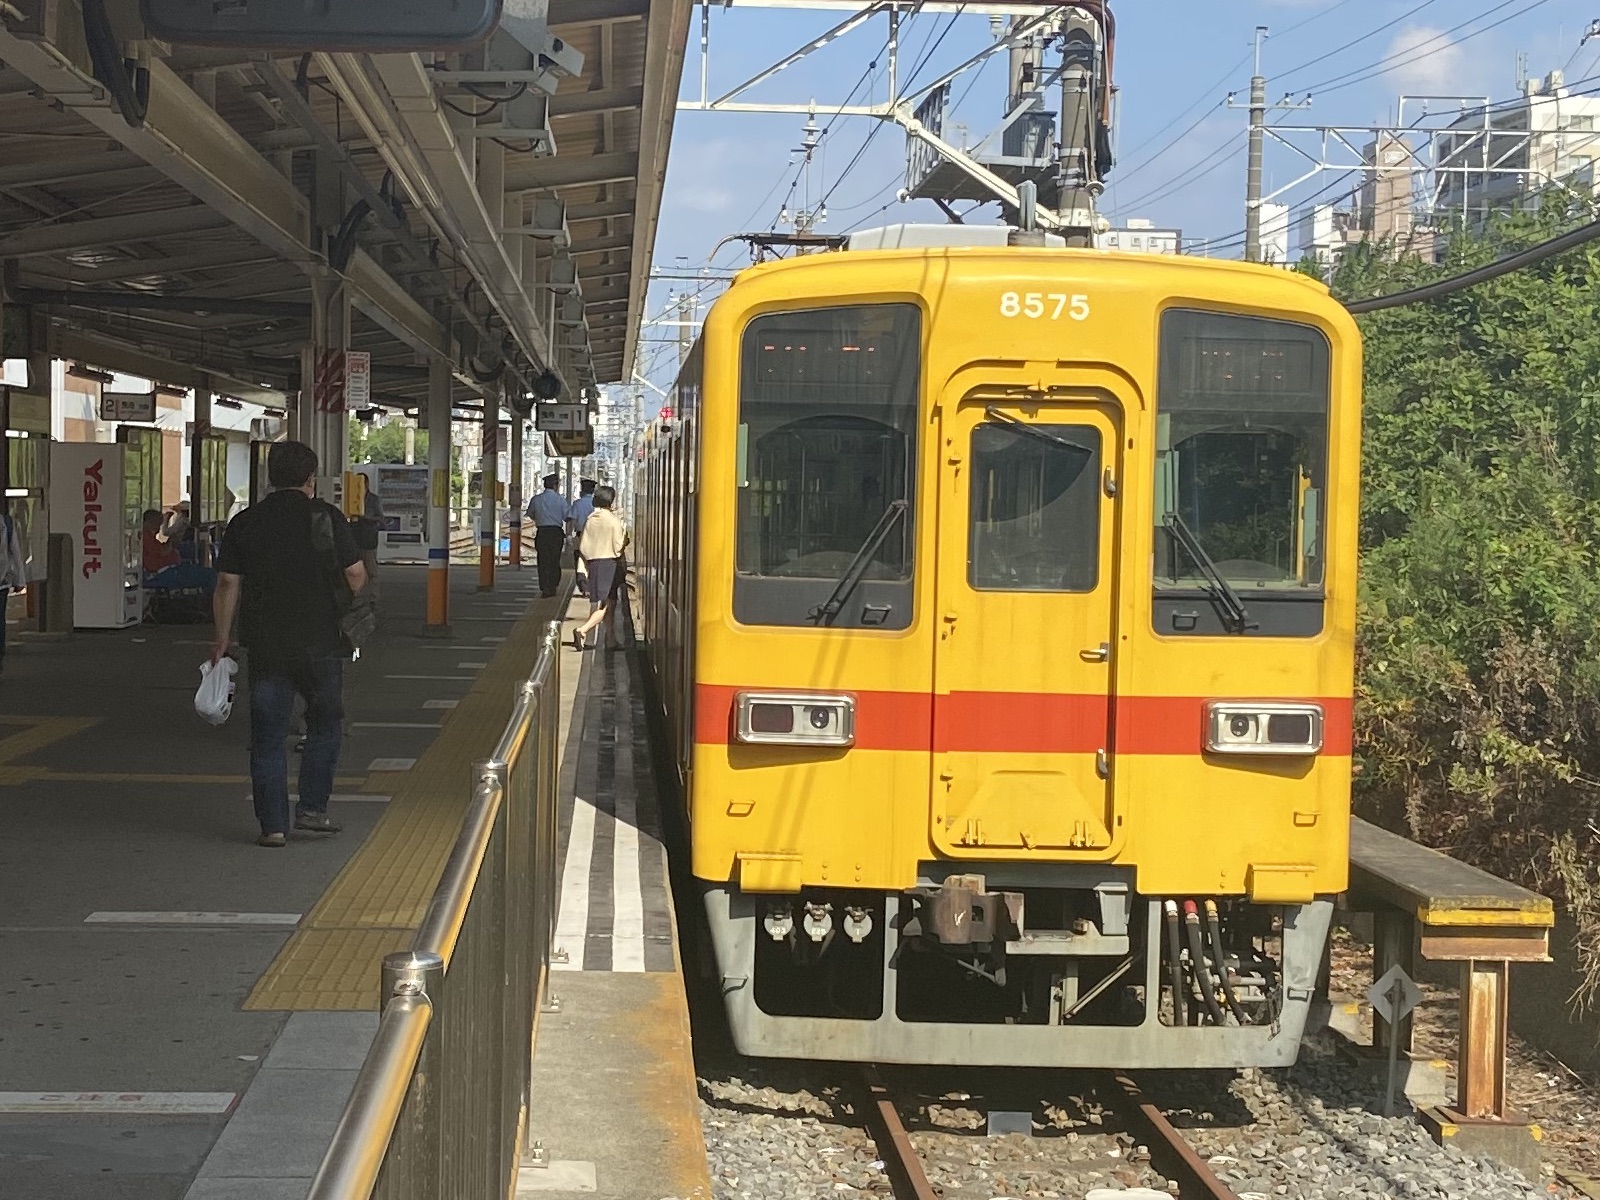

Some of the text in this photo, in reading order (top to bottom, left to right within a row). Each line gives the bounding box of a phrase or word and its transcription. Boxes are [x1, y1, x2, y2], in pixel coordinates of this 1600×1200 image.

[1000, 291, 1090, 322] 8575
[106, 399, 115, 413] 2
[577, 410, 582, 423] 1
[82, 459, 103, 580] Yakult
